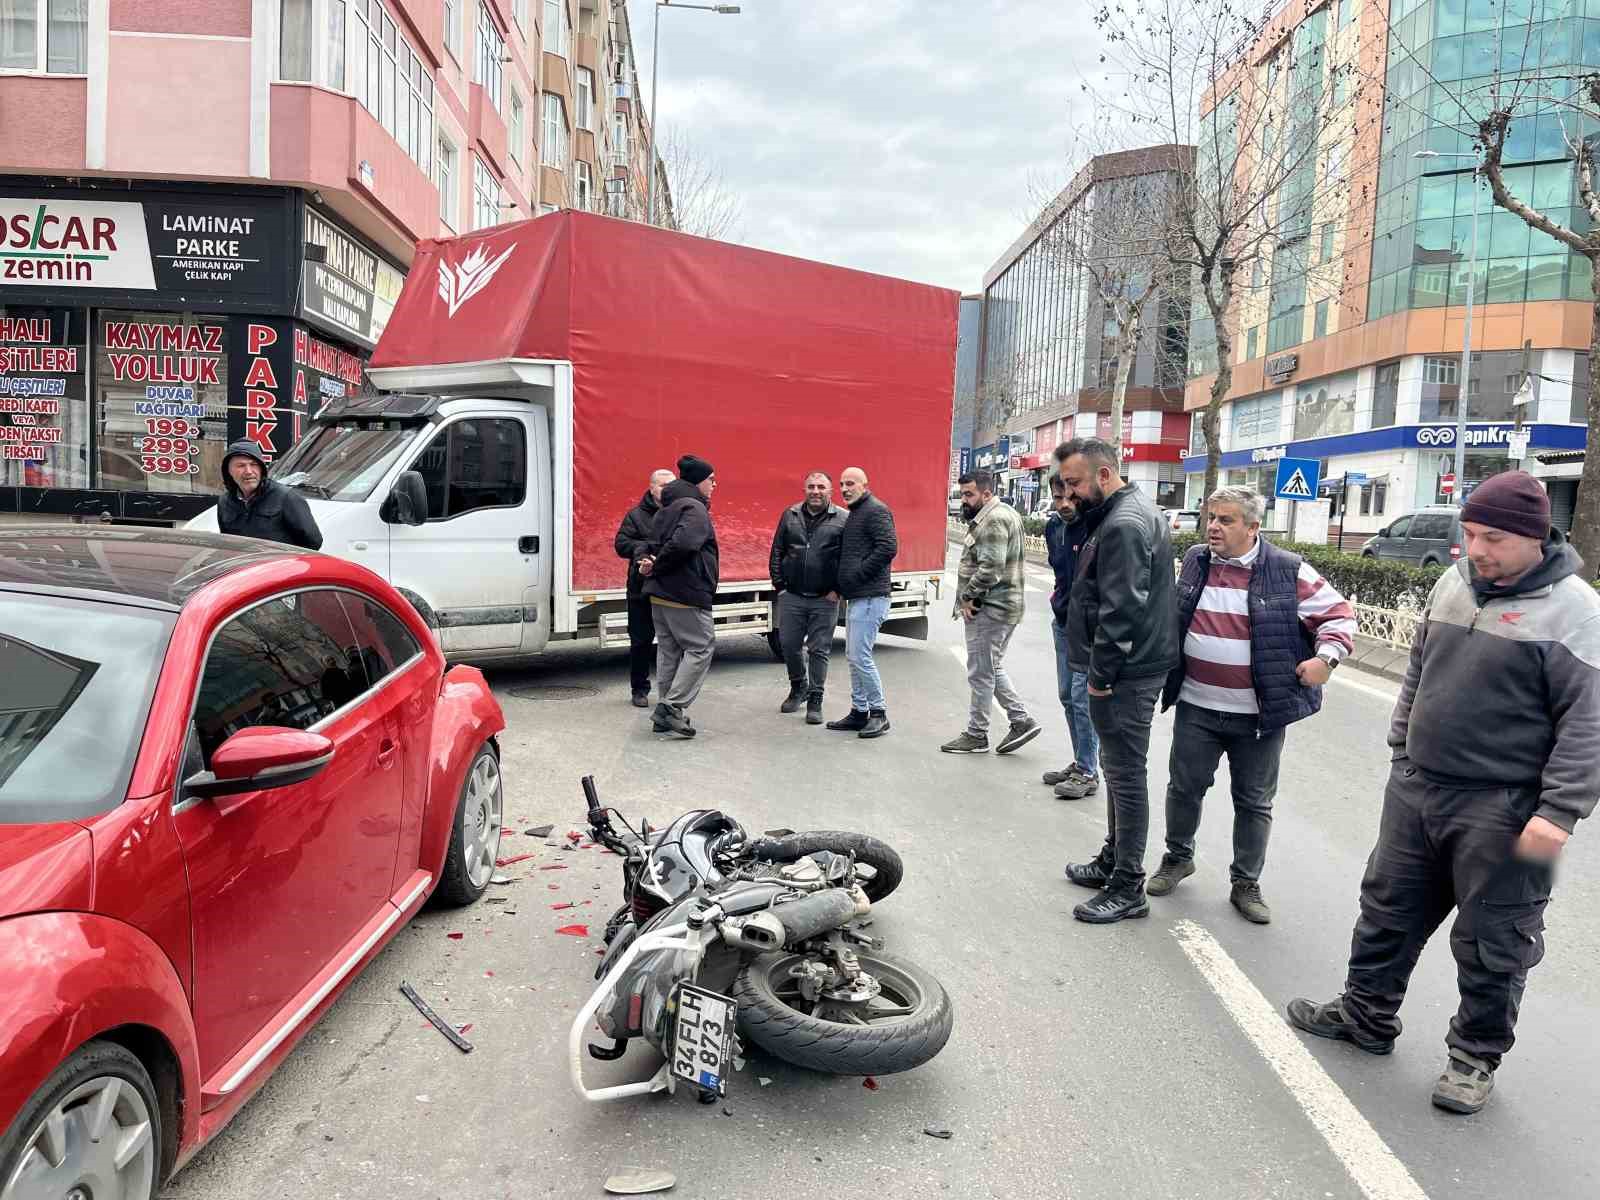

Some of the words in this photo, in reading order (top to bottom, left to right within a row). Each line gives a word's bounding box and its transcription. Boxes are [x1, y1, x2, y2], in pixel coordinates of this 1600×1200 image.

[176, 238, 239, 257] PARKE
[4, 253, 92, 281] zemin
[223, 262, 244, 271] KAPI
[347, 243, 375, 290] PARKE
[211, 272, 232, 281] KAPI
[0, 317, 51, 343] HALI
[105, 322, 223, 352] KAYMAZ
[109, 353, 220, 384] YOLLUK
[145, 386, 194, 401] DUVAR
[25, 399, 60, 415] KARTI
[134, 399, 206, 417] KAĞITLARI
[12, 415, 36, 425] VEYA
[3, 444, 45, 461] FIRSATI
[700, 1019, 722, 1067] 873
[709, 1075, 720, 1090] TR
